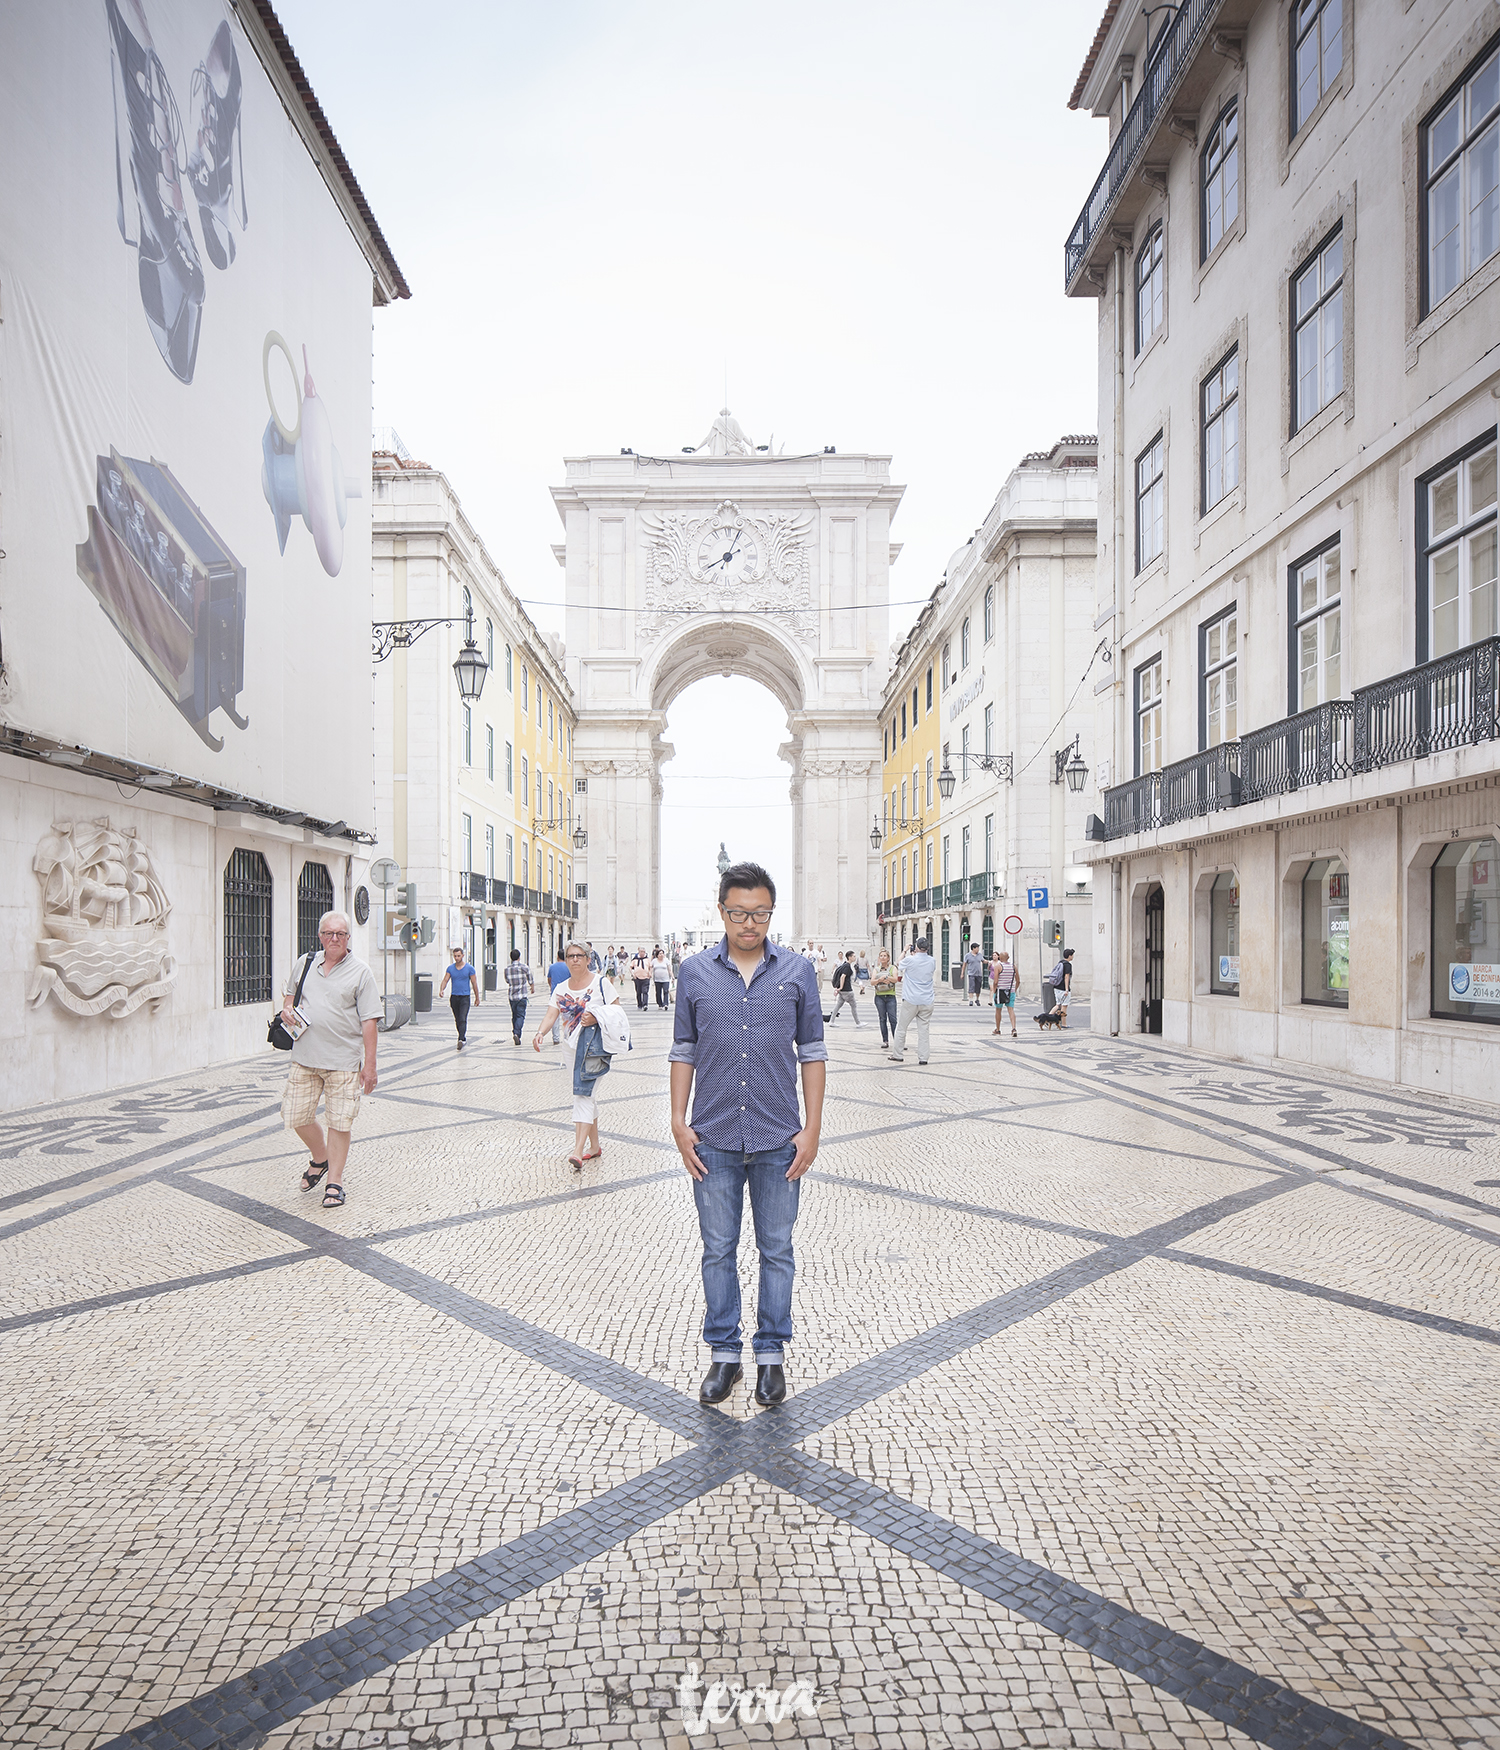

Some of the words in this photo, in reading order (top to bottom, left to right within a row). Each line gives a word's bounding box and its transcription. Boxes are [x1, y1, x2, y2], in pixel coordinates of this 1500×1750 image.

[1031, 890, 1044, 907] P
[1473, 965, 1492, 973] MARCA
[1473, 974, 1480, 982] DE
[1473, 987, 1489, 997] 2014
